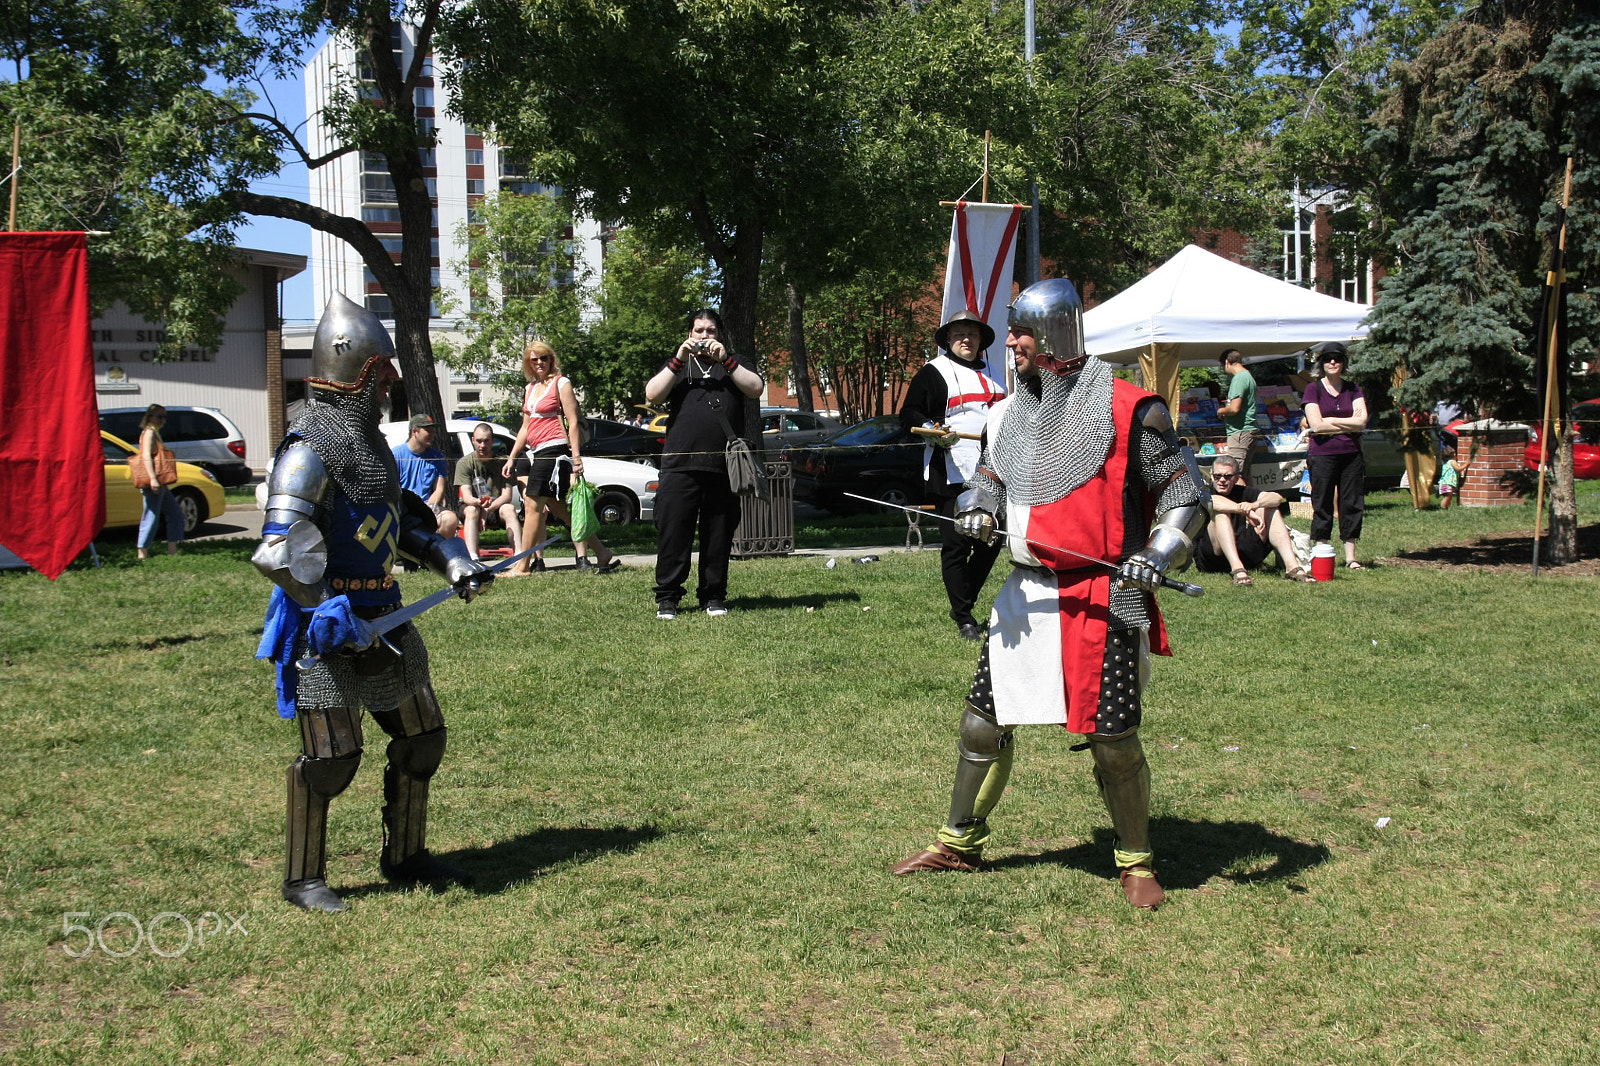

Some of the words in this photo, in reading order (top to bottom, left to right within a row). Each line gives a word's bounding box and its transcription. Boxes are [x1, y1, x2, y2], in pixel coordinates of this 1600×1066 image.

[136, 330, 167, 342] SID
[139, 350, 211, 362] CPEL
[1281, 466, 1306, 483] Boo
